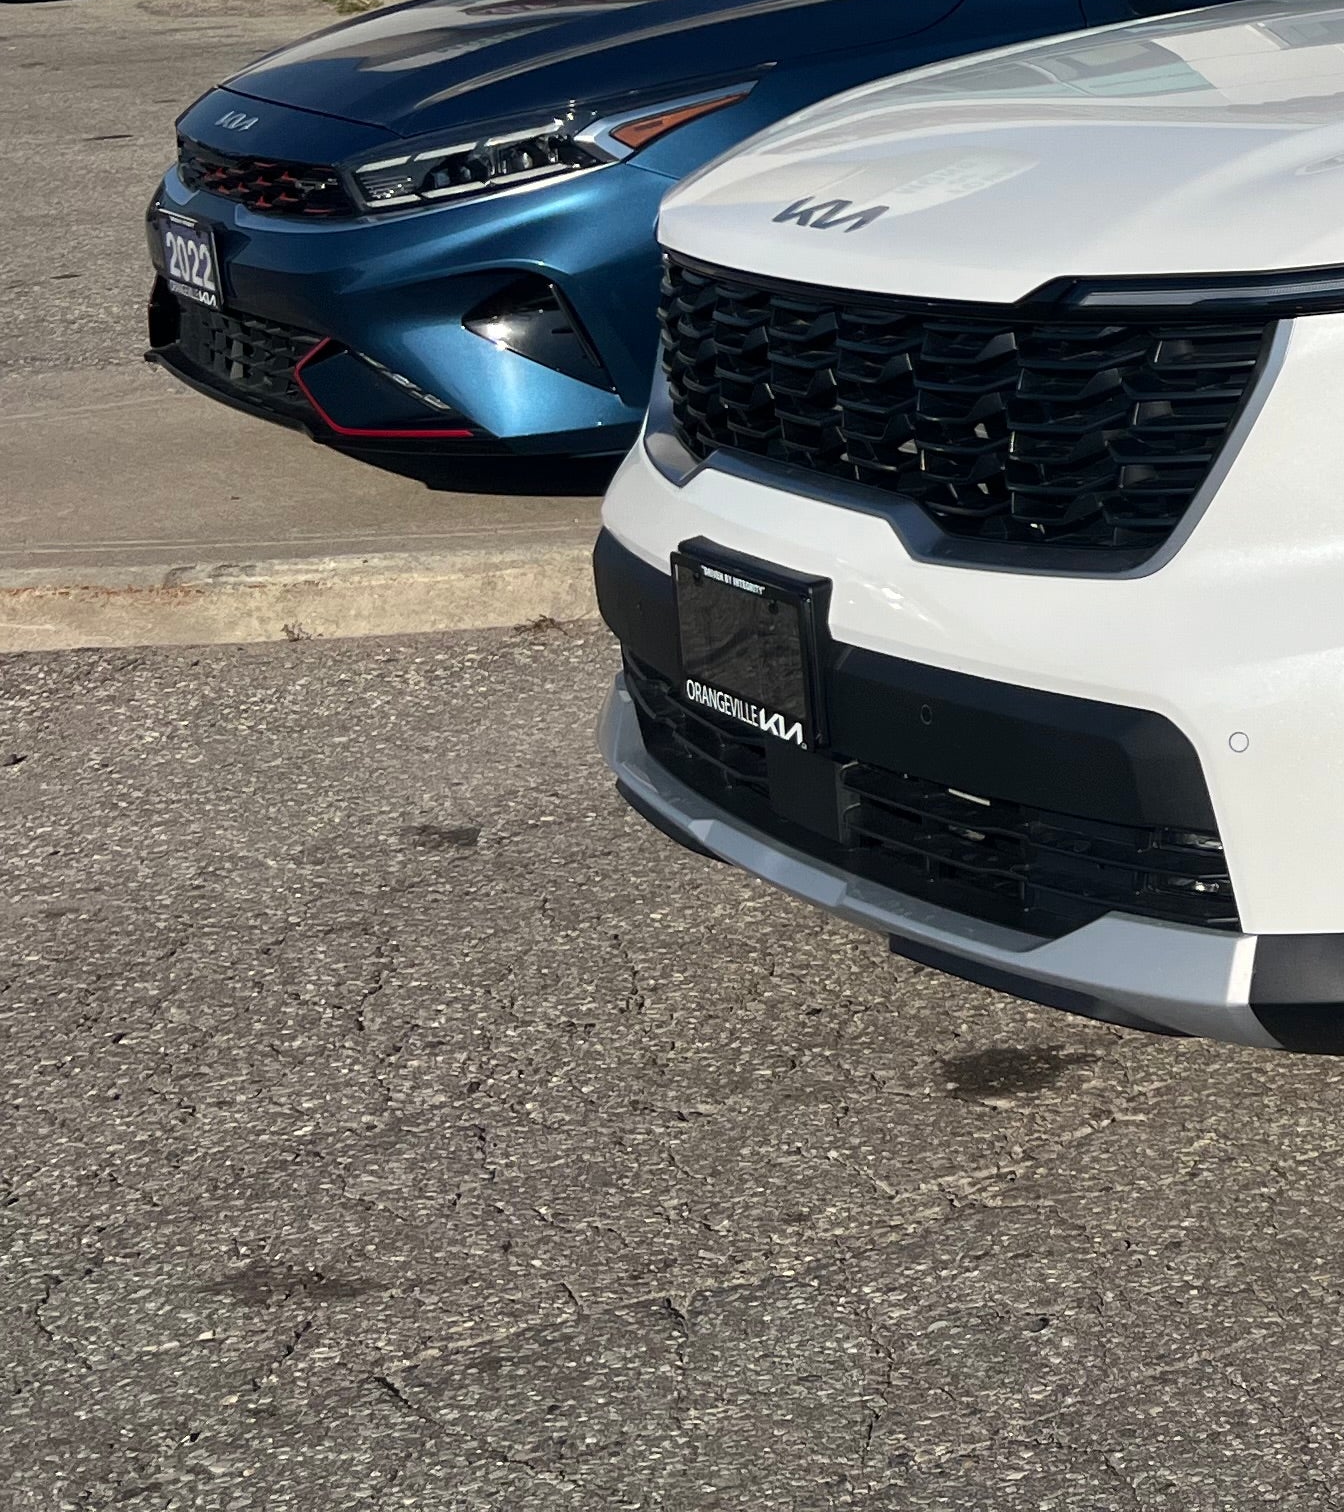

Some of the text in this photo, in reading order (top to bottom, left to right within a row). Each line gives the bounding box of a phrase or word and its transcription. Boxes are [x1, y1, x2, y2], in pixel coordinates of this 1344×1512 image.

[214, 110, 259, 132] KIA
[771, 195, 890, 234] KIA
[165, 231, 216, 291] 2022
[686, 679, 803, 746] ORANGEVILLE KIA
